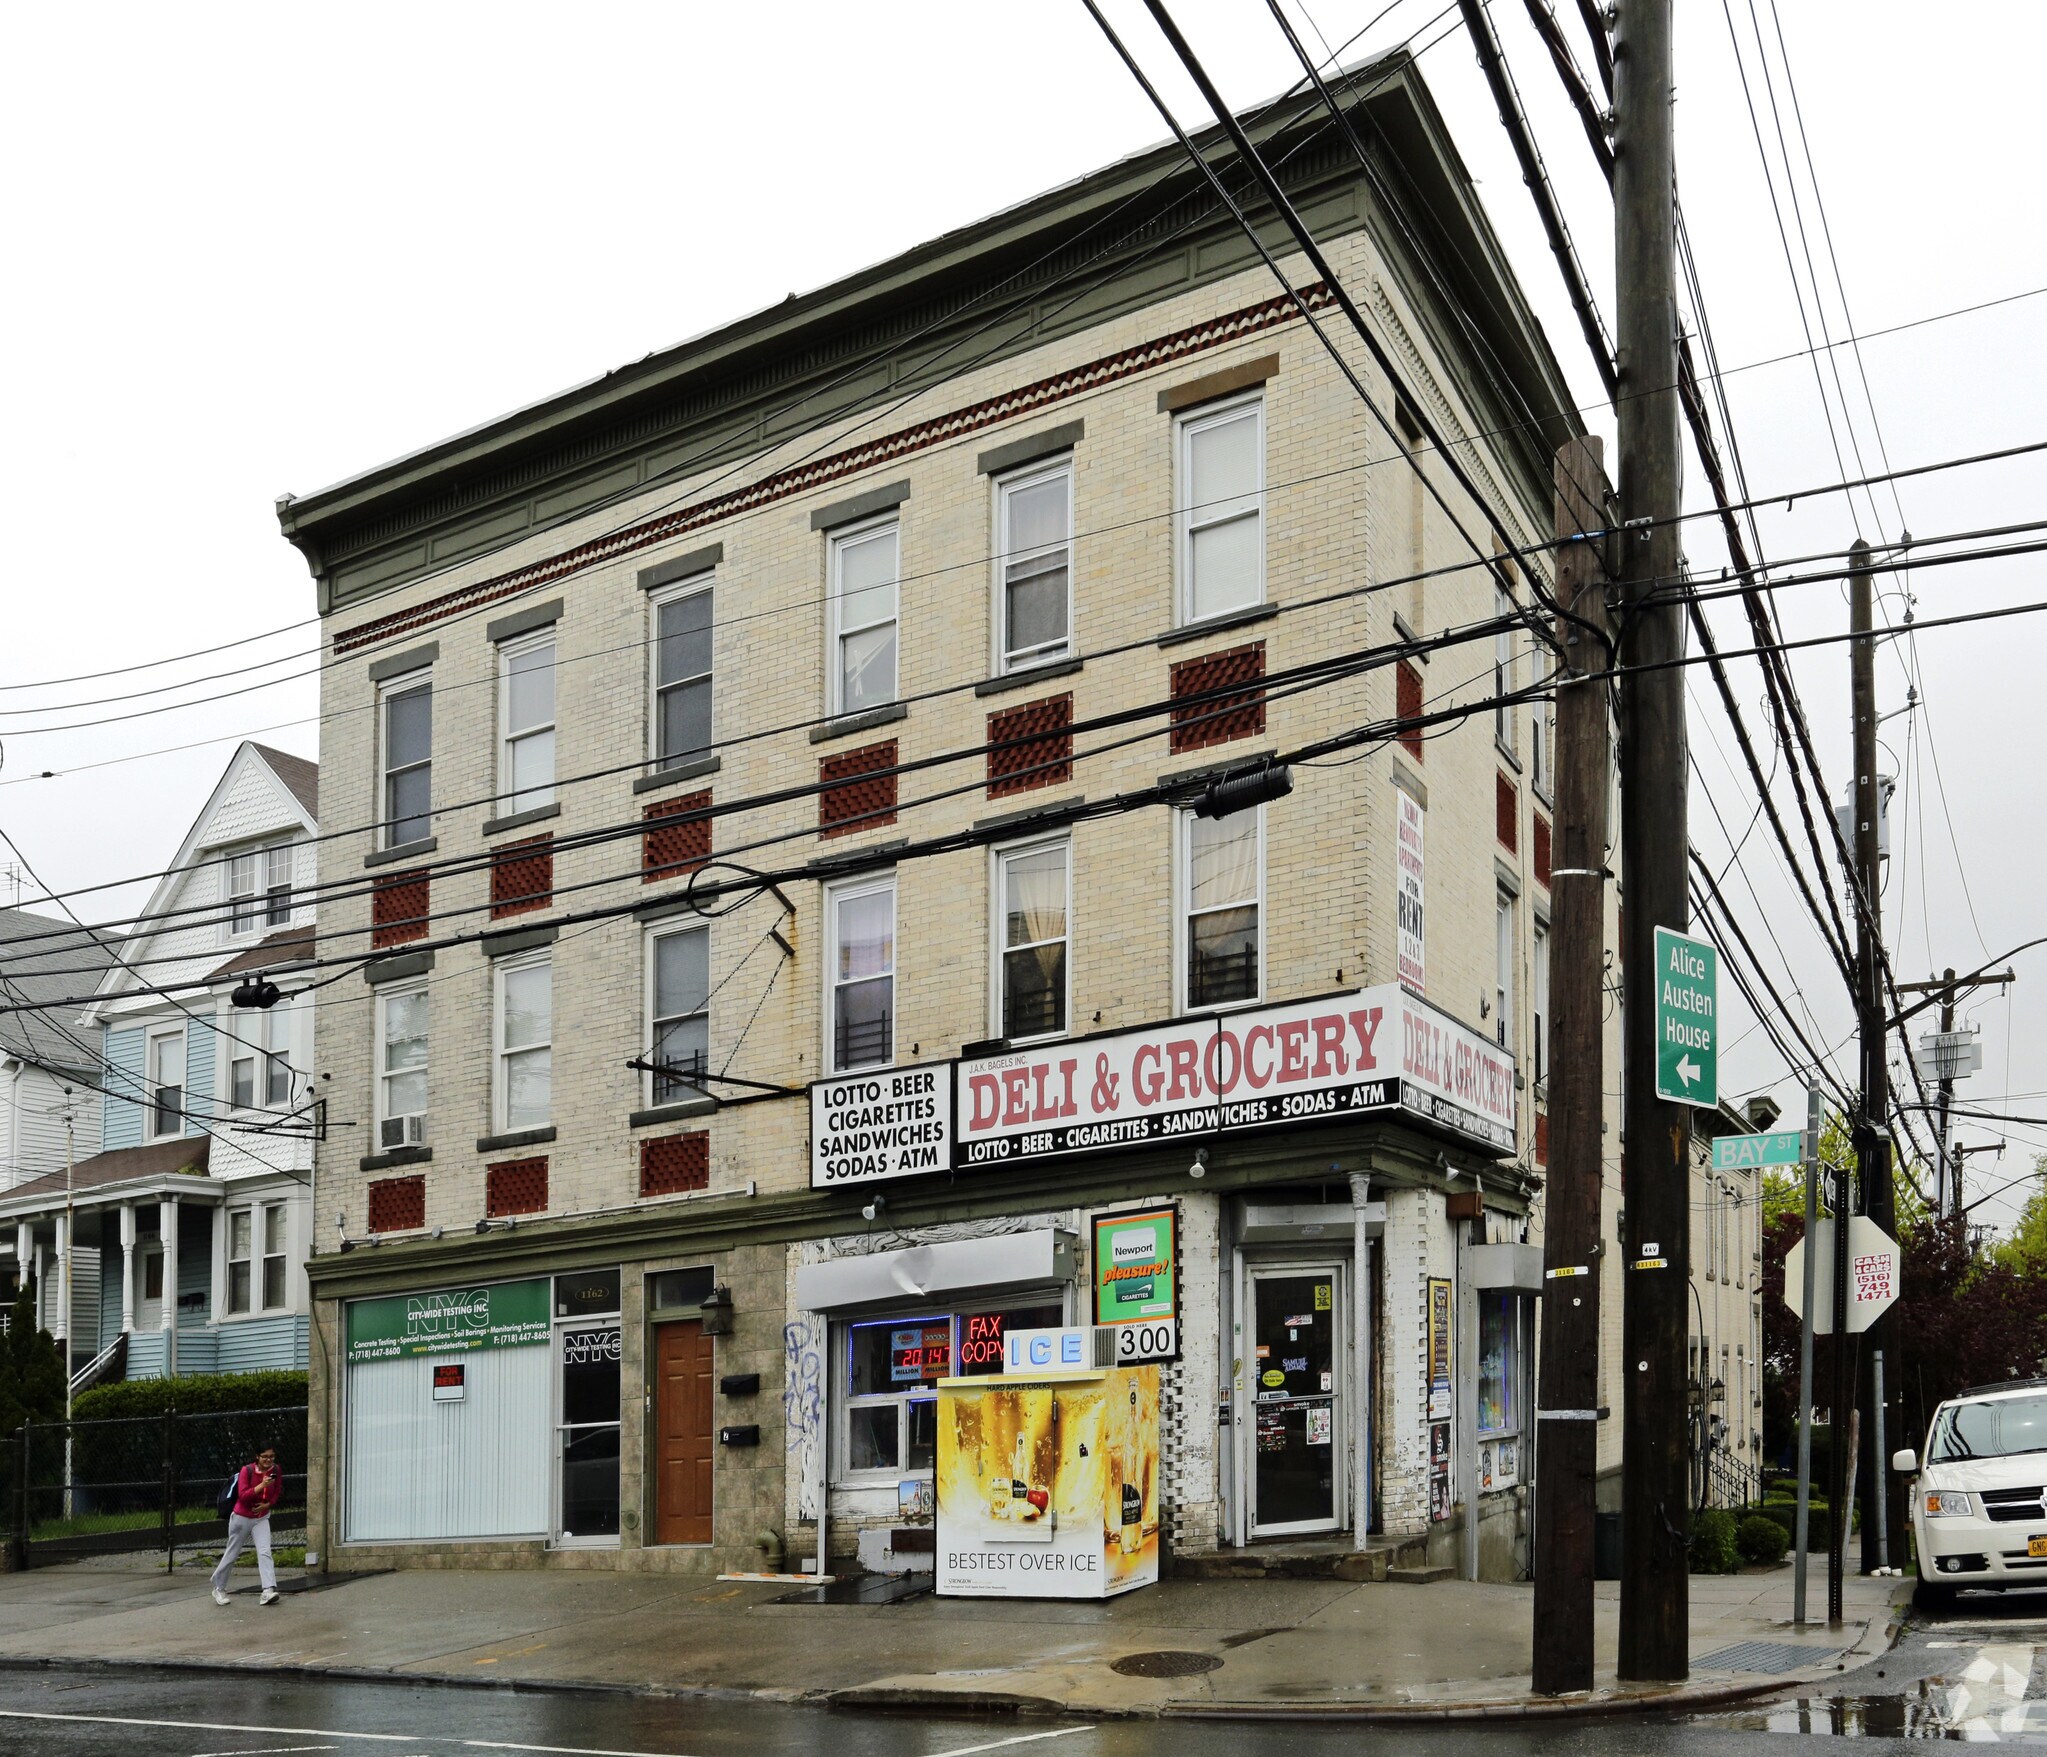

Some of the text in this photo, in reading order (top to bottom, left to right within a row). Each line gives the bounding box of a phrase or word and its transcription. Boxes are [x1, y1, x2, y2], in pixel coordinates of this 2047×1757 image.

[1406, 876, 1419, 899] FOR
[1399, 890, 1423, 941] RENT
[1670, 946, 1705, 980] Alice
[1663, 980, 1712, 1017] Austen
[1666, 1016, 1710, 1051] House
[969, 1055, 1028, 1074] J.A.K. BAGELS INC.
[969, 1007, 1383, 1131] DELI & GROCERY
[1403, 1009, 1513, 1120] DELI & GROCERY
[824, 1072, 935, 1108] LOTTO BEER
[828, 1097, 935, 1132] CIGARETTES
[1402, 1084, 1418, 1108] LOTTO
[1421, 1093, 1433, 1114] BEER
[1435, 1099, 1460, 1126] CIGARETTES
[968, 1083, 1385, 1162] LOTTO BEER CIGARETTES SANDWICHES SODAS ATM
[820, 1121, 944, 1158] SANDWICHES
[1720, 1135, 1793, 1166] BAY ST
[826, 1146, 938, 1180] SODAS ATM
[1115, 1244, 1153, 1257] Newport
[1103, 1258, 1169, 1286] pleasure!
[1856, 1266, 1862, 1274] 4
[1857, 1272, 1890, 1284] (516)
[582, 1289, 603, 1299] 1162
[1121, 1292, 1149, 1301] CIGARETTES
[1856, 1290, 1892, 1302] 1471
[1859, 1282, 1889, 1292] 749
[408, 1289, 489, 1335] NYC
[408, 1303, 489, 1321] CITY-WIDE TESTING INC.
[354, 1321, 547, 1349] Concrete Testing Special Inspections Soil Borings Monitoring Services
[500, 1333, 518, 1345] (718)
[519, 1330, 551, 1342] 447-8605
[970, 1316, 1000, 1340] FAX
[355, 1349, 371, 1361] (718)
[371, 1346, 401, 1357] 447-8600
[412, 1339, 482, 1353] www.citywidetesting.com
[564, 1331, 621, 1364] NYC
[565, 1345, 590, 1353] CITY-WIDE
[590, 1343, 611, 1351] TESTING
[961, 1341, 1004, 1363] COPY
[1011, 1333, 1082, 1367] ICE
[902, 1349, 922, 1367] 20
[1282, 1357, 1308, 1367] SAMUEL
[440, 1366, 458, 1376] FOR
[895, 1368, 919, 1376] MILLION
[924, 1366, 950, 1374] MILLION
[1285, 1363, 1307, 1373] ADAMS
[435, 1376, 462, 1386] RENT
[1027, 1382, 1050, 1390] CIDERS
[949, 1553, 1097, 1571] BESTEST OVER ICE
